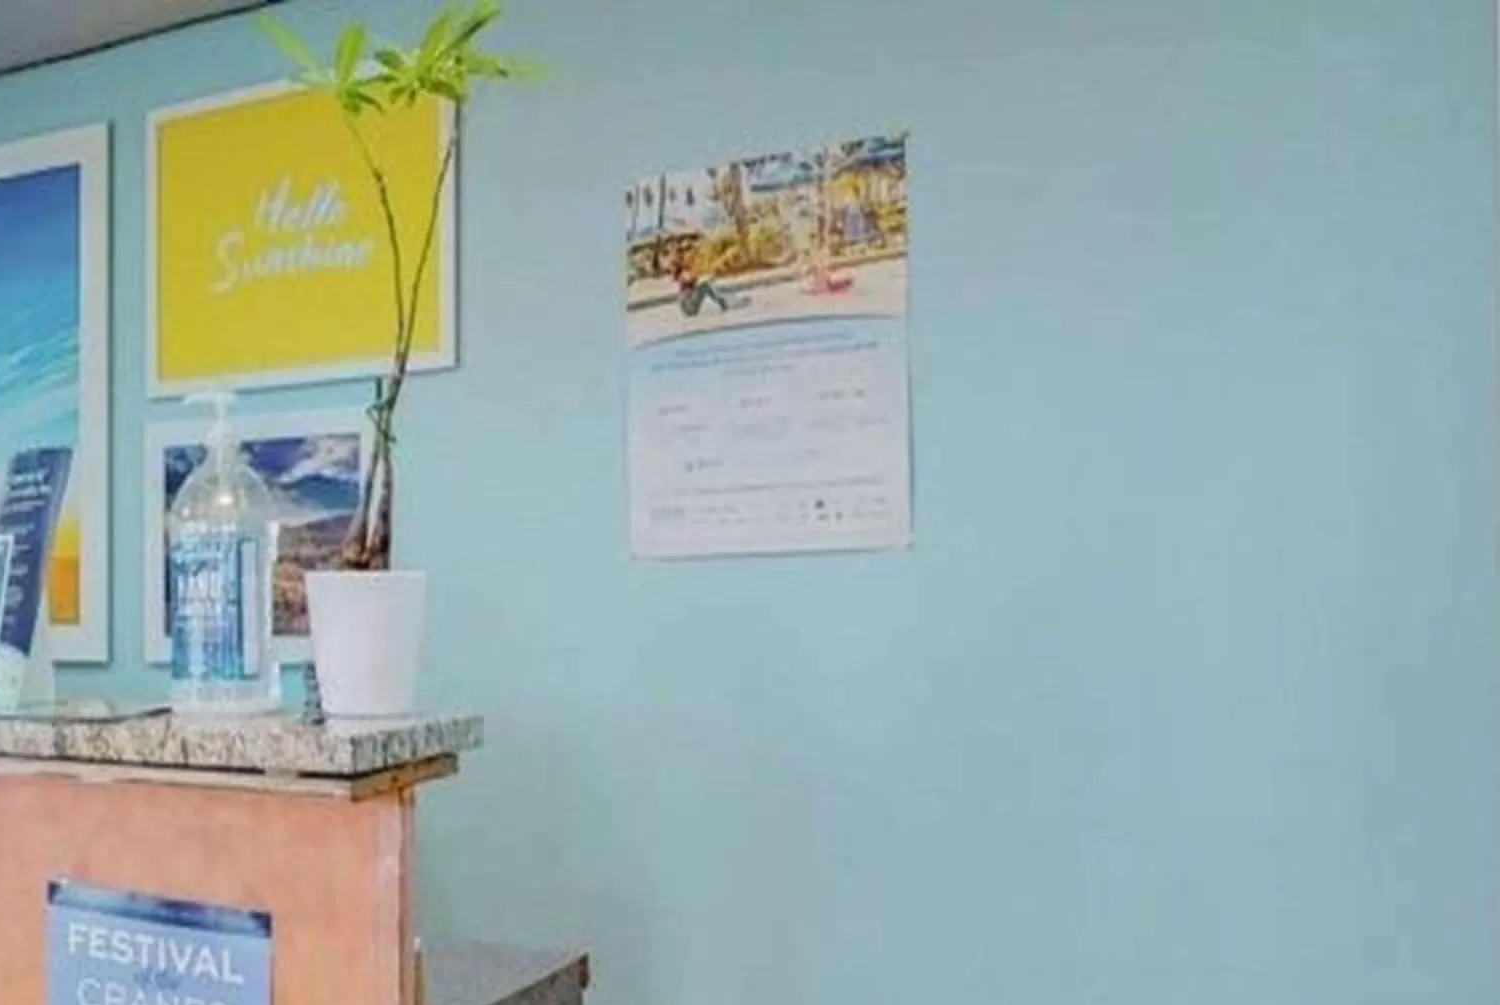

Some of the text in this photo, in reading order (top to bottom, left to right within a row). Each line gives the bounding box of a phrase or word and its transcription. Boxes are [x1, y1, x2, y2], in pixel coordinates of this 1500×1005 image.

[255, 174, 346, 235] Hello
[208, 227, 375, 294] Sunshine
[67, 923, 244, 984] FESTIVAL
